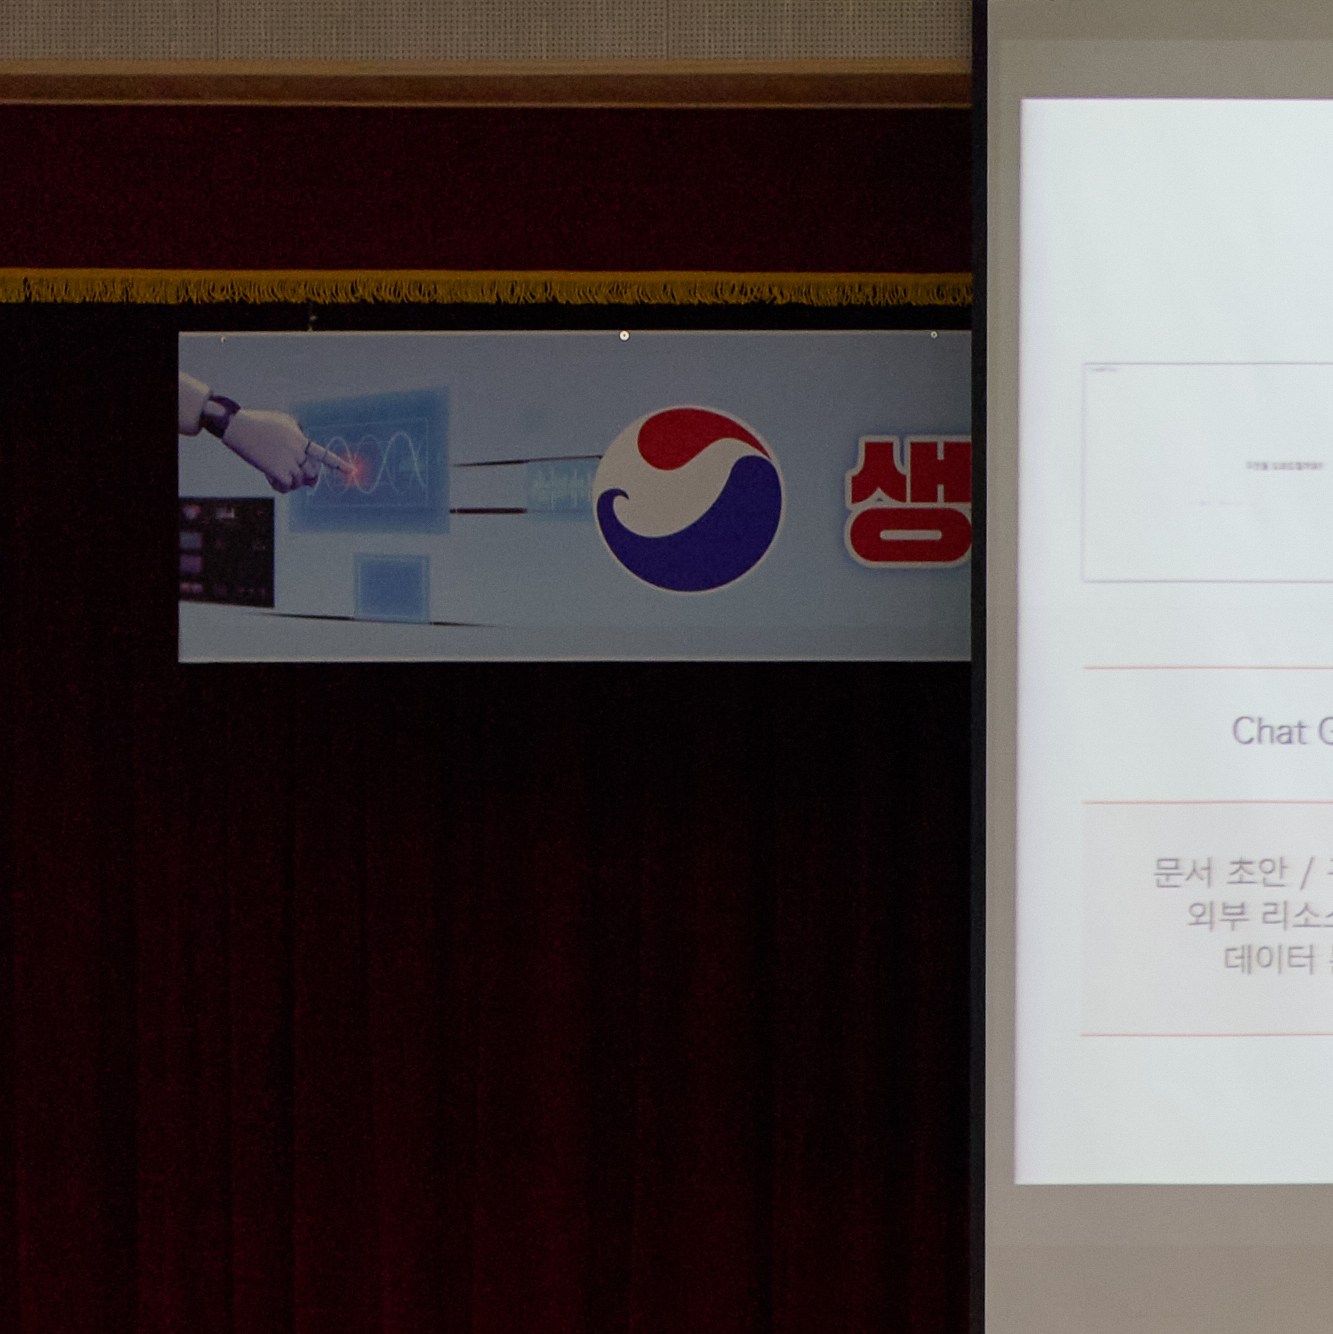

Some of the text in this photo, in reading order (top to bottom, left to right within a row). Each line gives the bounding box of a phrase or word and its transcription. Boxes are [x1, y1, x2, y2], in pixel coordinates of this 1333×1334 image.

[1232, 715, 1308, 746] Chat
[1154, 857, 1213, 889] 문서
[1226, 857, 1288, 889] 초안
[1299, 856, 1316, 891] /
[1187, 900, 1250, 932] 외부
[1223, 944, 1316, 975] 데이터
